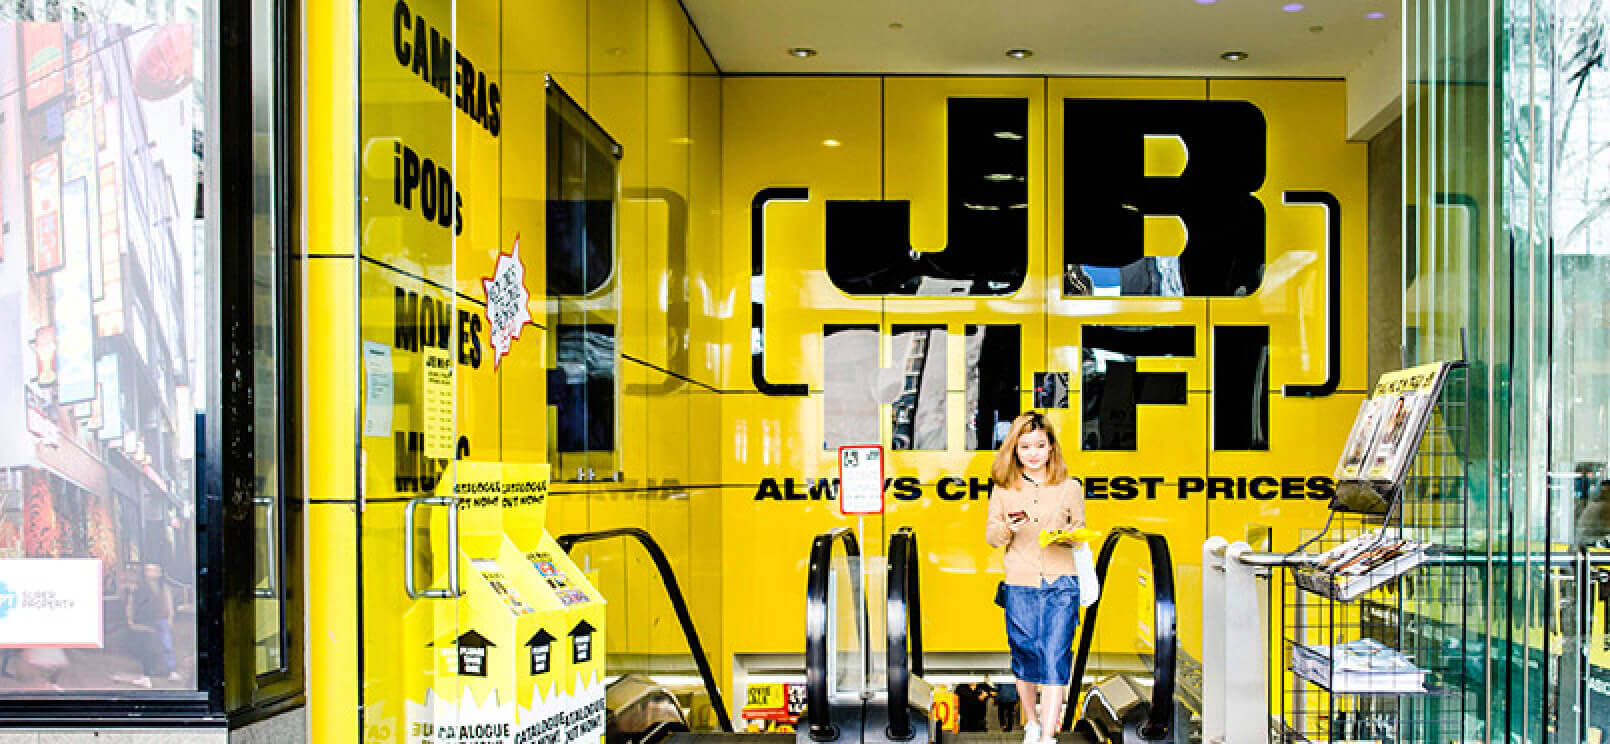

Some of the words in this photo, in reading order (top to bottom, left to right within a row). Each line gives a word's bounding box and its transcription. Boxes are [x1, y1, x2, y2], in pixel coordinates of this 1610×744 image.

[393, 0, 500, 137] CAMERAS
[825, 97, 1267, 297] JB
[393, 285, 482, 369] MOVES
[823, 323, 1271, 451] HI-FI
[754, 477, 923, 501] ALWS
[935, 477, 1165, 501] CHEST
[1177, 476, 1336, 501] PRICES
[564, 697, 605, 727] ATALOGUE
